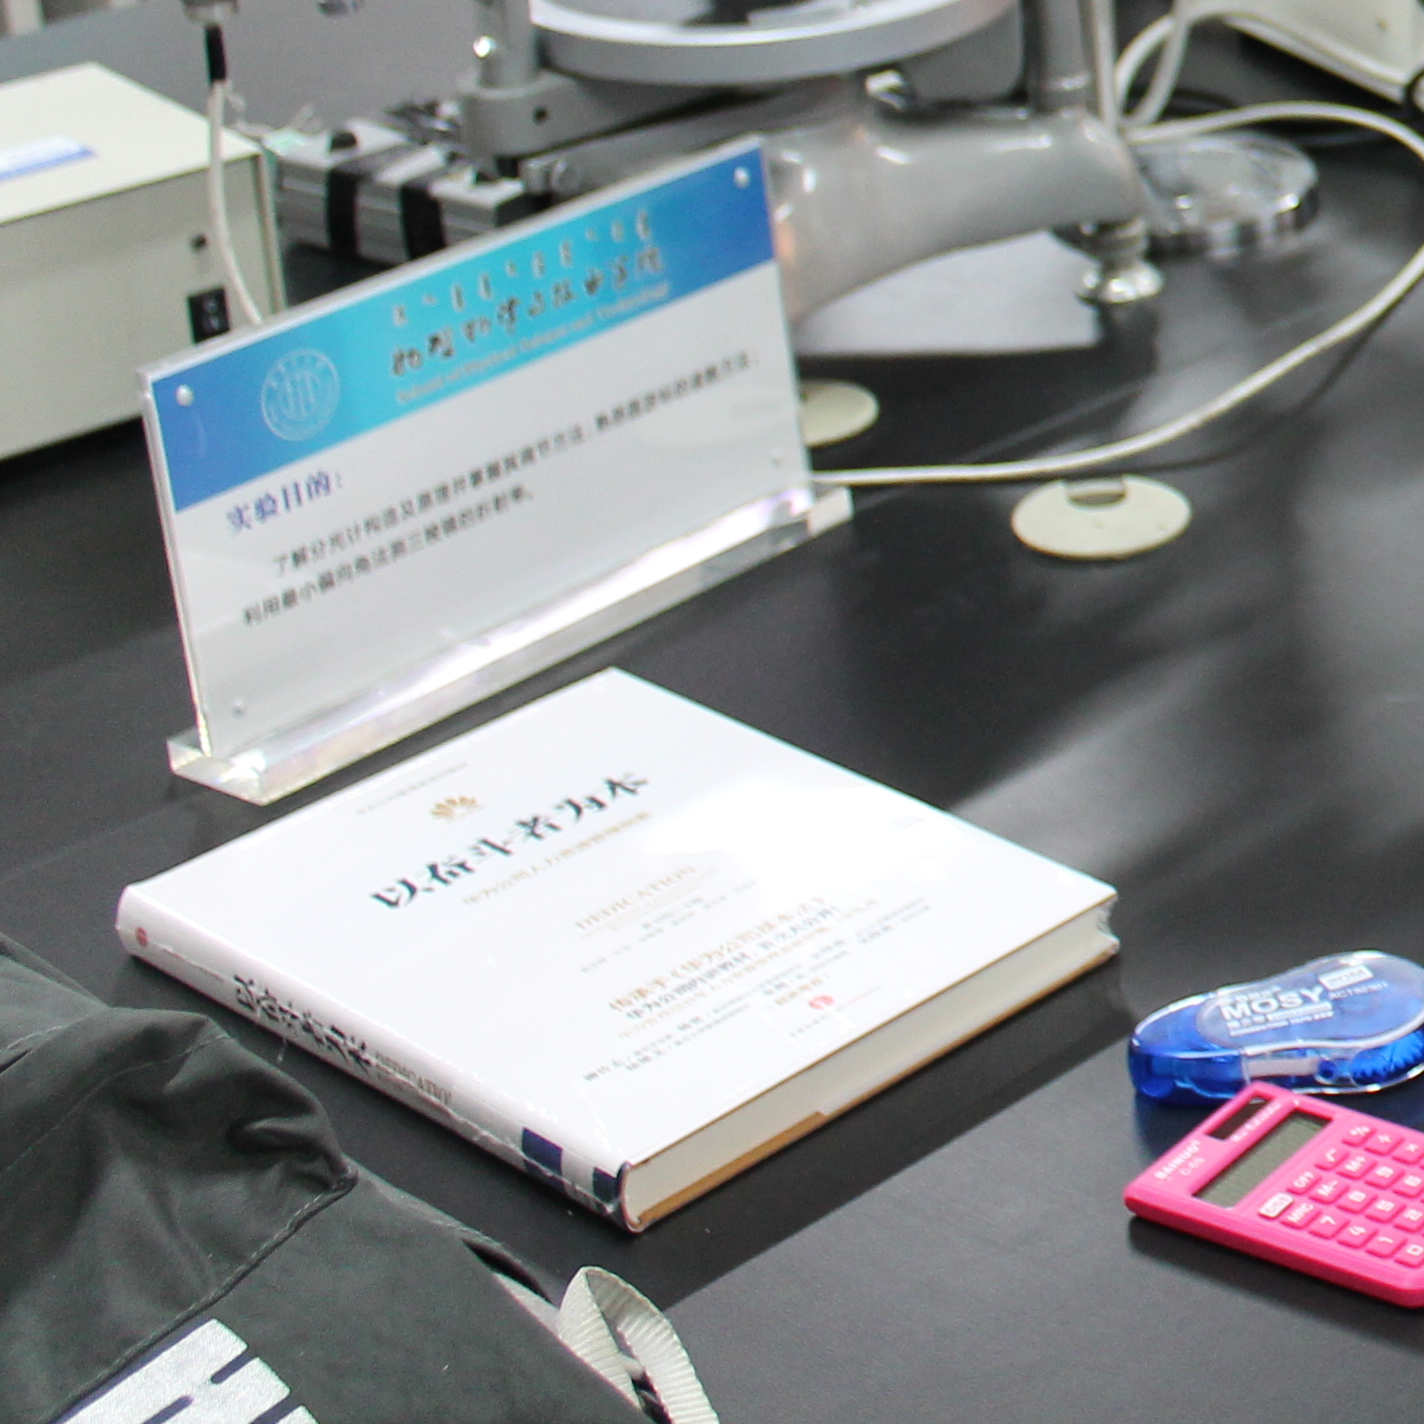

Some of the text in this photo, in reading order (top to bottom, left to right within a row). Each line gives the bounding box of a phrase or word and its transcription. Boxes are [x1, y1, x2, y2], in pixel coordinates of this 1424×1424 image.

[370, 772, 650, 909] 以奋斗者为本
[574, 865, 697, 930] DEDICATION
[1219, 985, 1326, 1021] MOSY
[1319, 1215, 1337, 1226] 7
